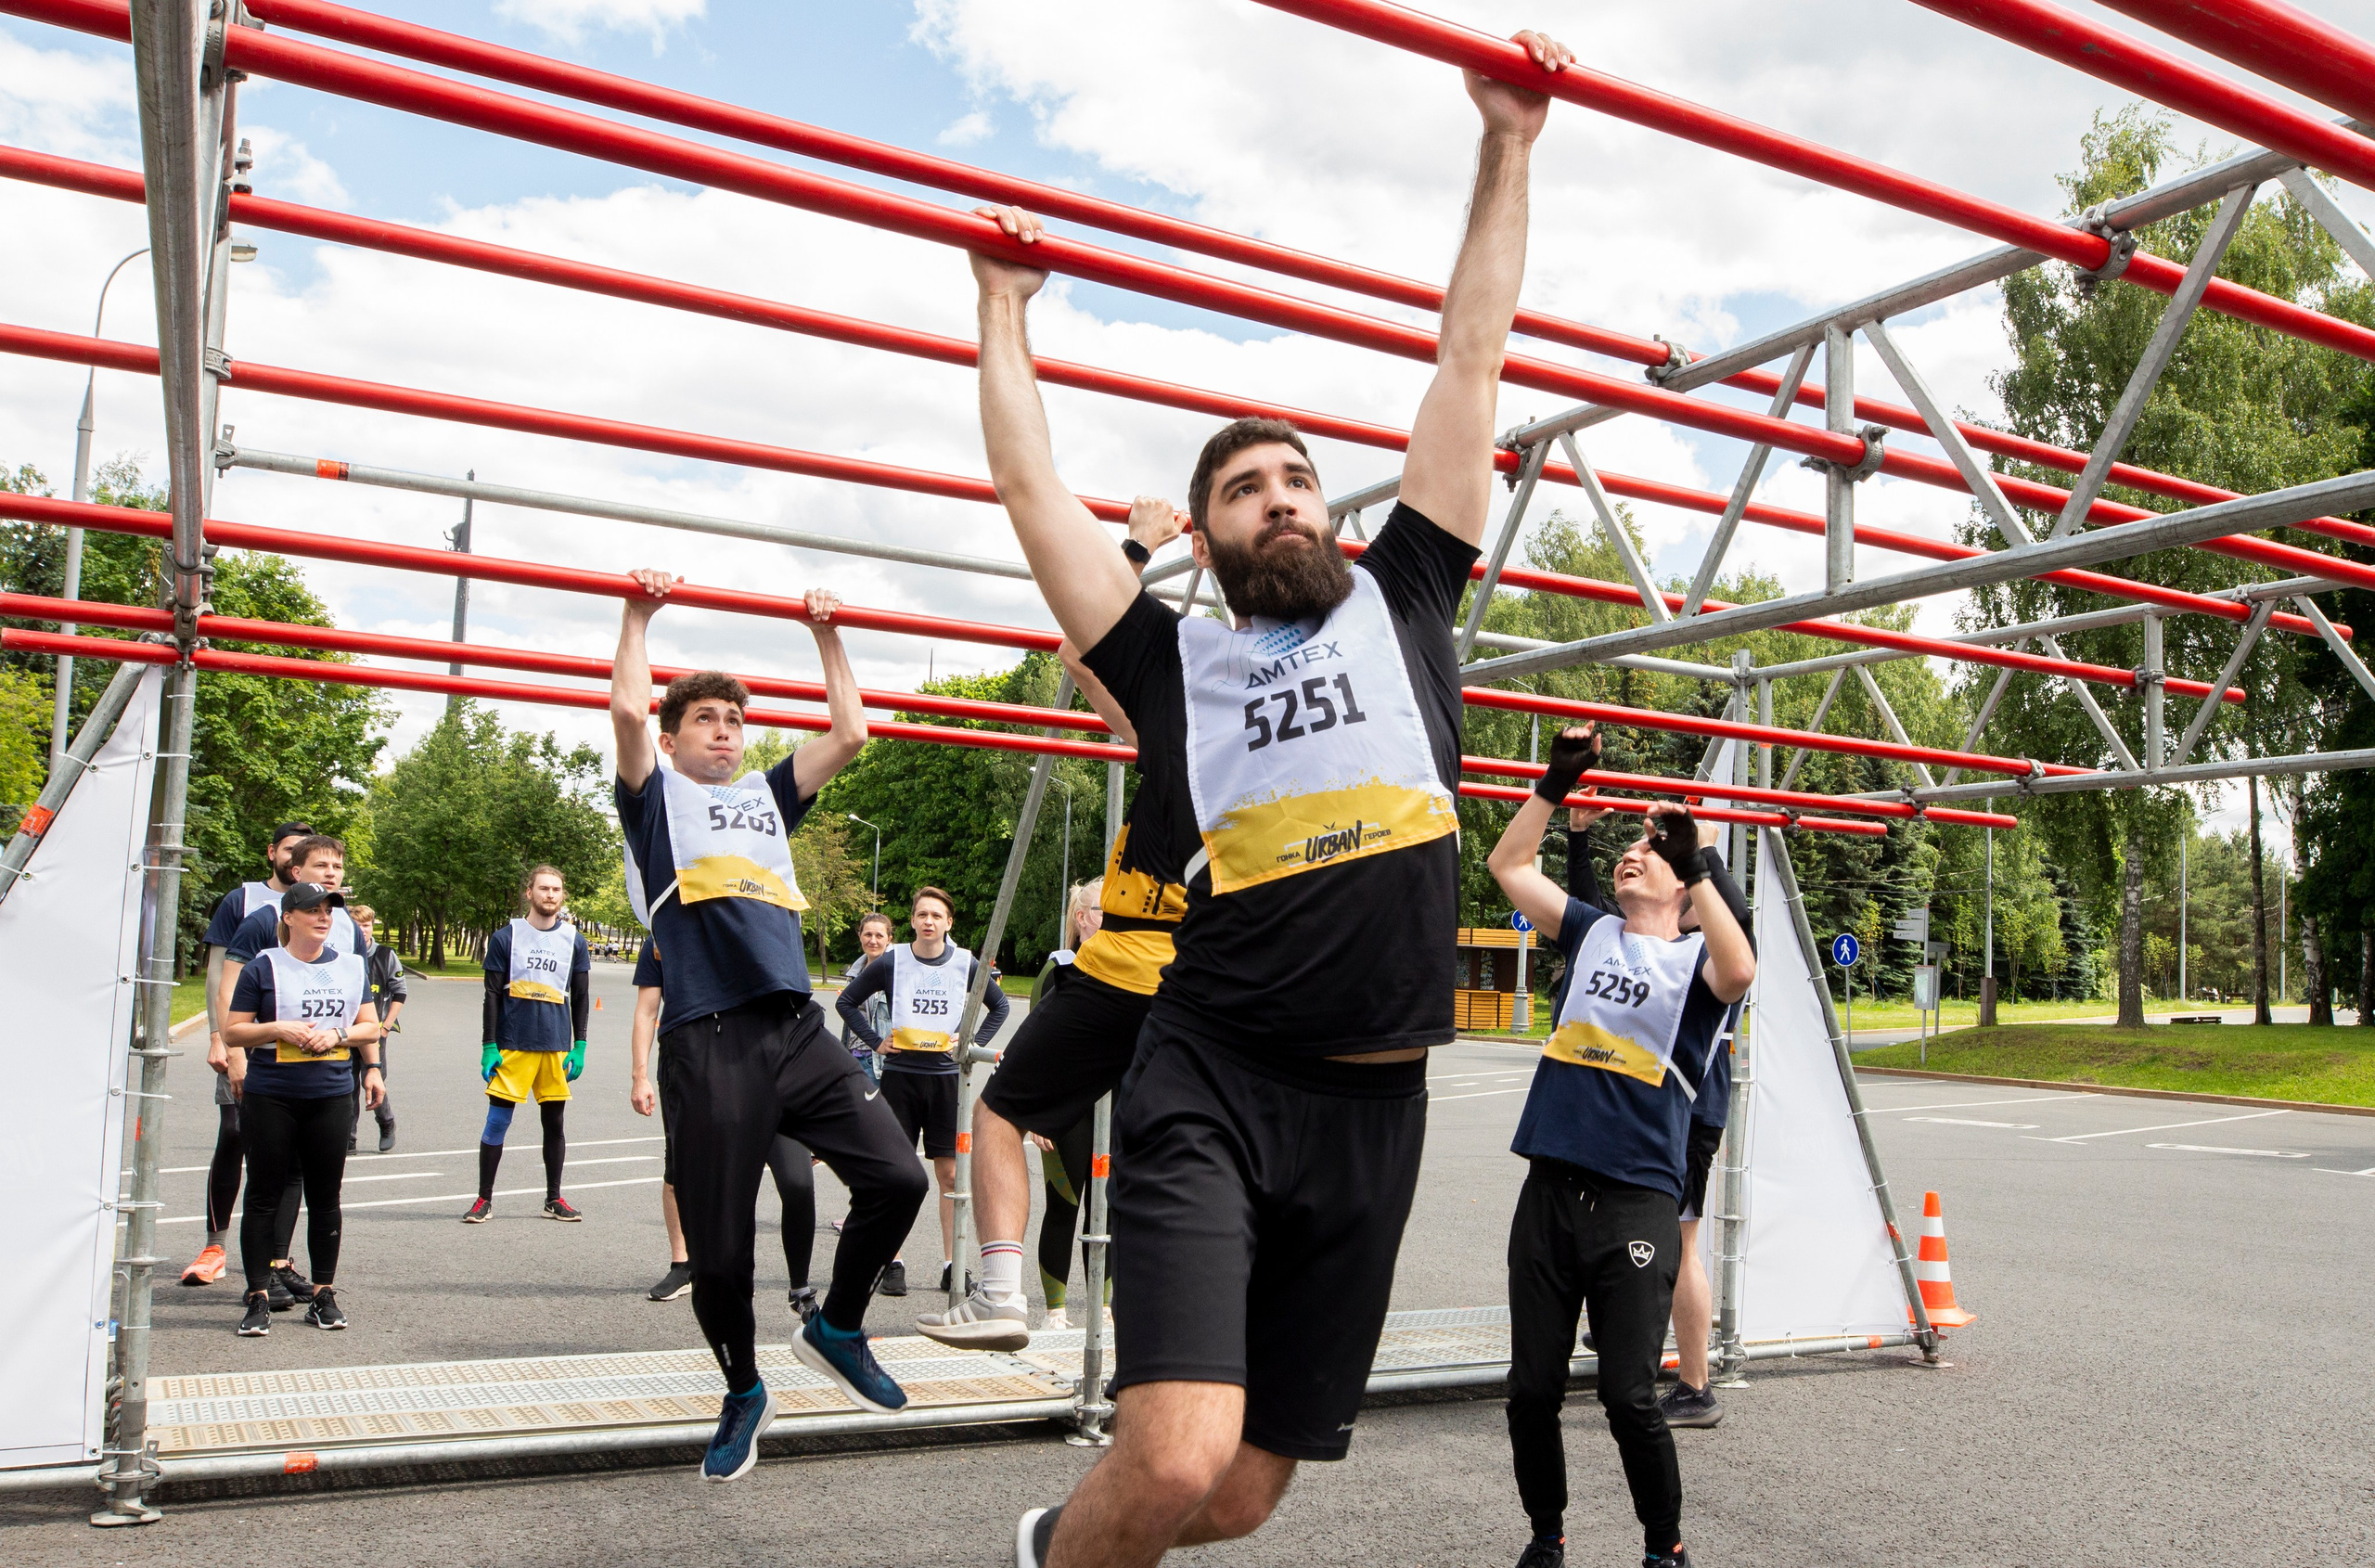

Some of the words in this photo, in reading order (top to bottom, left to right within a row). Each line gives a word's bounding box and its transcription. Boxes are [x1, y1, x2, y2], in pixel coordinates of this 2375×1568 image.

[1244, 641, 1342, 689] AMTEX
[1244, 673, 1367, 752] 5251
[1276, 851, 1301, 863] ГОНКА
[1305, 819, 1362, 864] URBAN
[1364, 829, 1392, 841] ГЕРОЕВ
[739, 879, 764, 896] URBAN
[526, 957, 558, 972] 5260
[1585, 970, 1650, 1009] 5259
[302, 999, 345, 1018] 5252
[912, 998, 948, 1015] 5253
